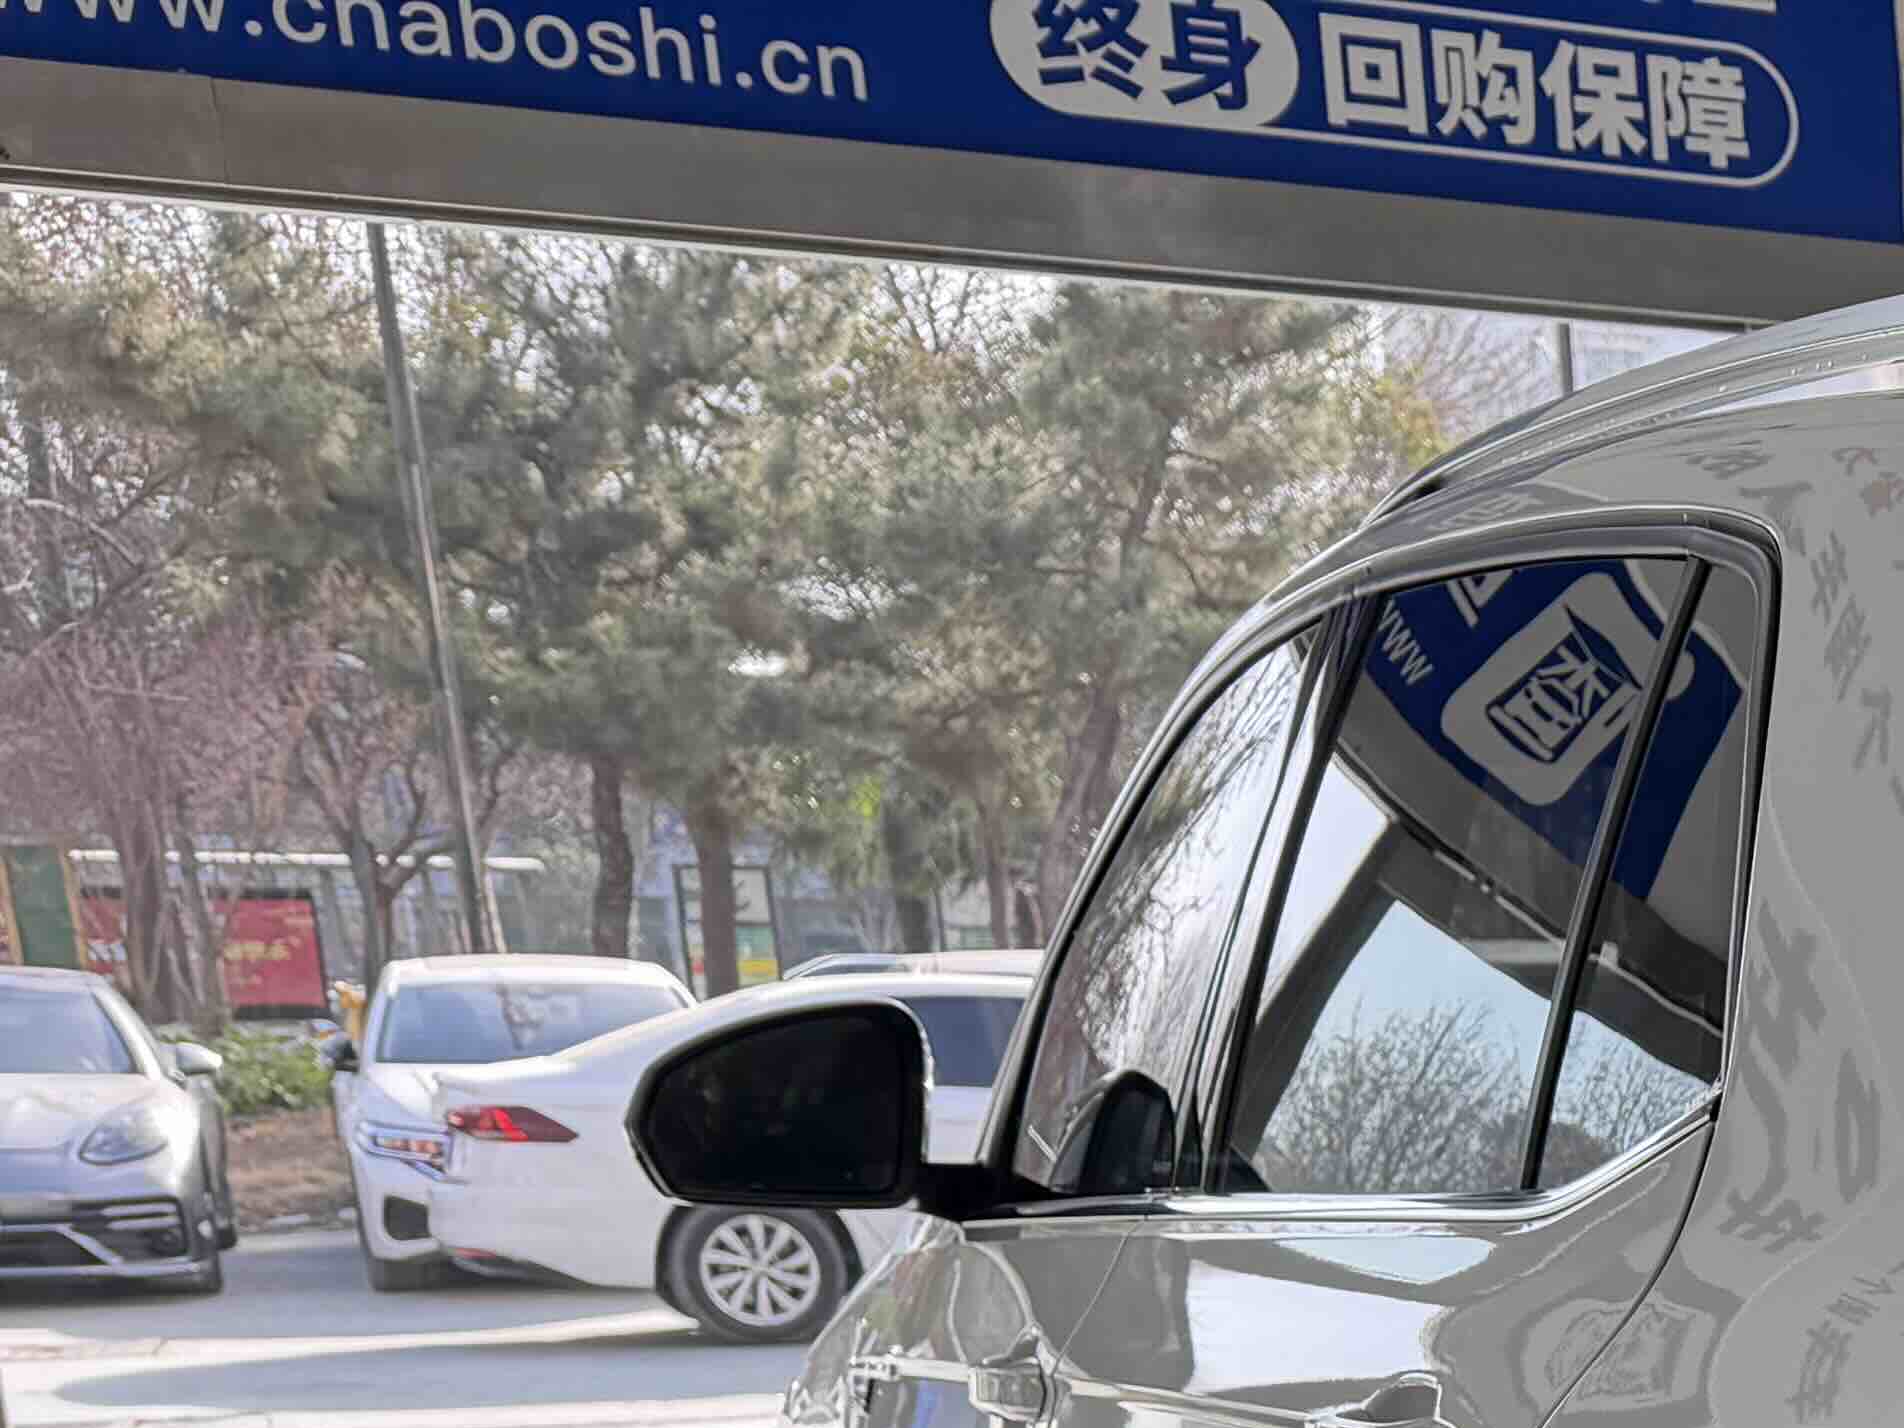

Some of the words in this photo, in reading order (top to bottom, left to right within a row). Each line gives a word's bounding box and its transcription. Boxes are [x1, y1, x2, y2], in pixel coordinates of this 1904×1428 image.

[0, 0, 869, 101] w.chaboshi.cn
[1035, 0, 1262, 111] 终身
[1320, 12, 1752, 169] 回购保障
